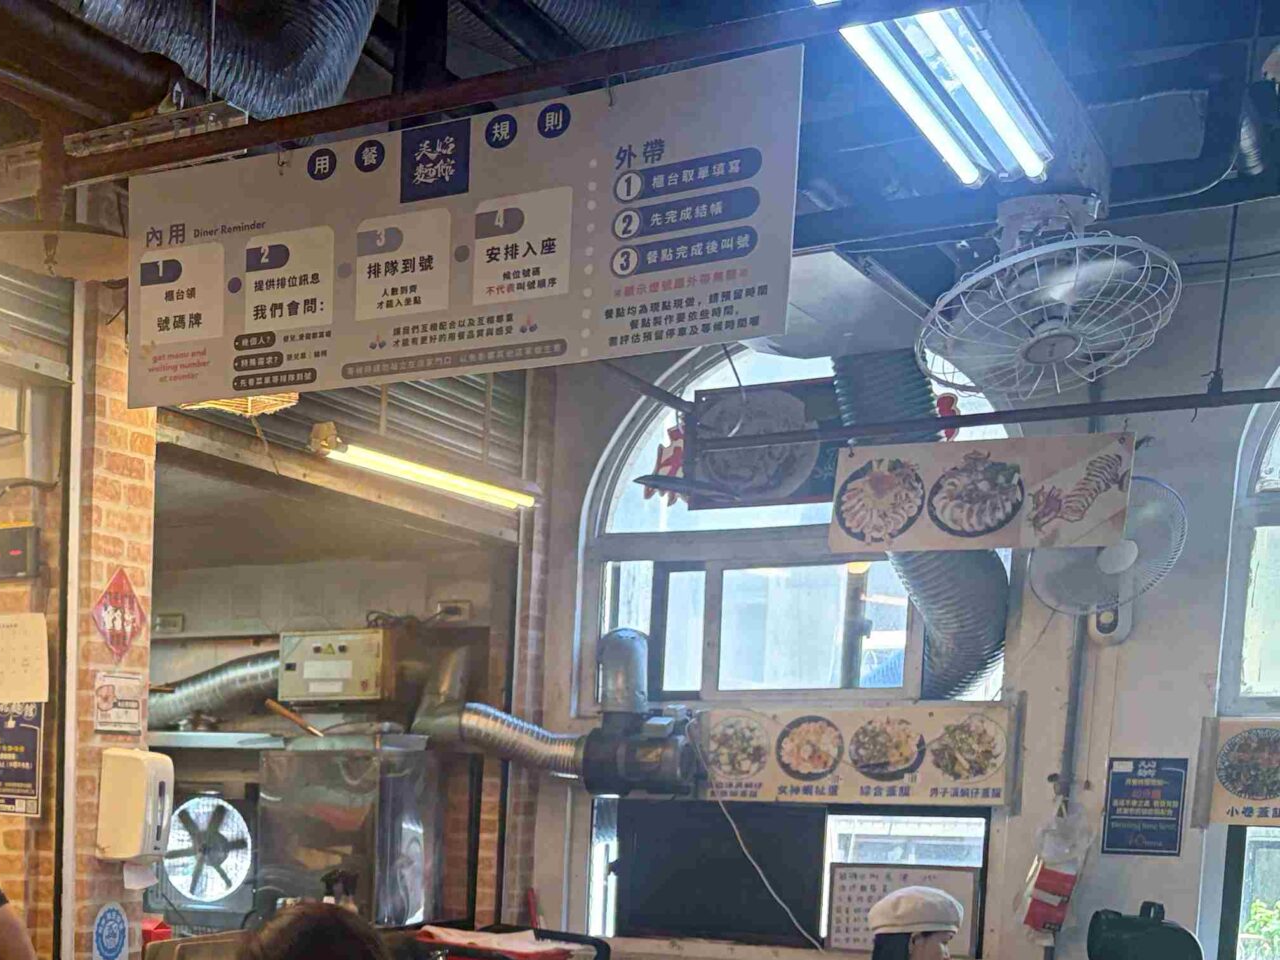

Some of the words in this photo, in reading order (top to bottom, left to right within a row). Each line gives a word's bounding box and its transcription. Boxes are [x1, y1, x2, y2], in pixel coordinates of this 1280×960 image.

[615, 139, 665, 170] 外帶
[146, 223, 186, 248] 內用
[193, 227, 219, 239] Diner
[220, 220, 266, 235] Reminder
[486, 237, 557, 264] 安排入座
[367, 255, 434, 279] 排隊到號
[157, 312, 202, 332] 號碼牌
